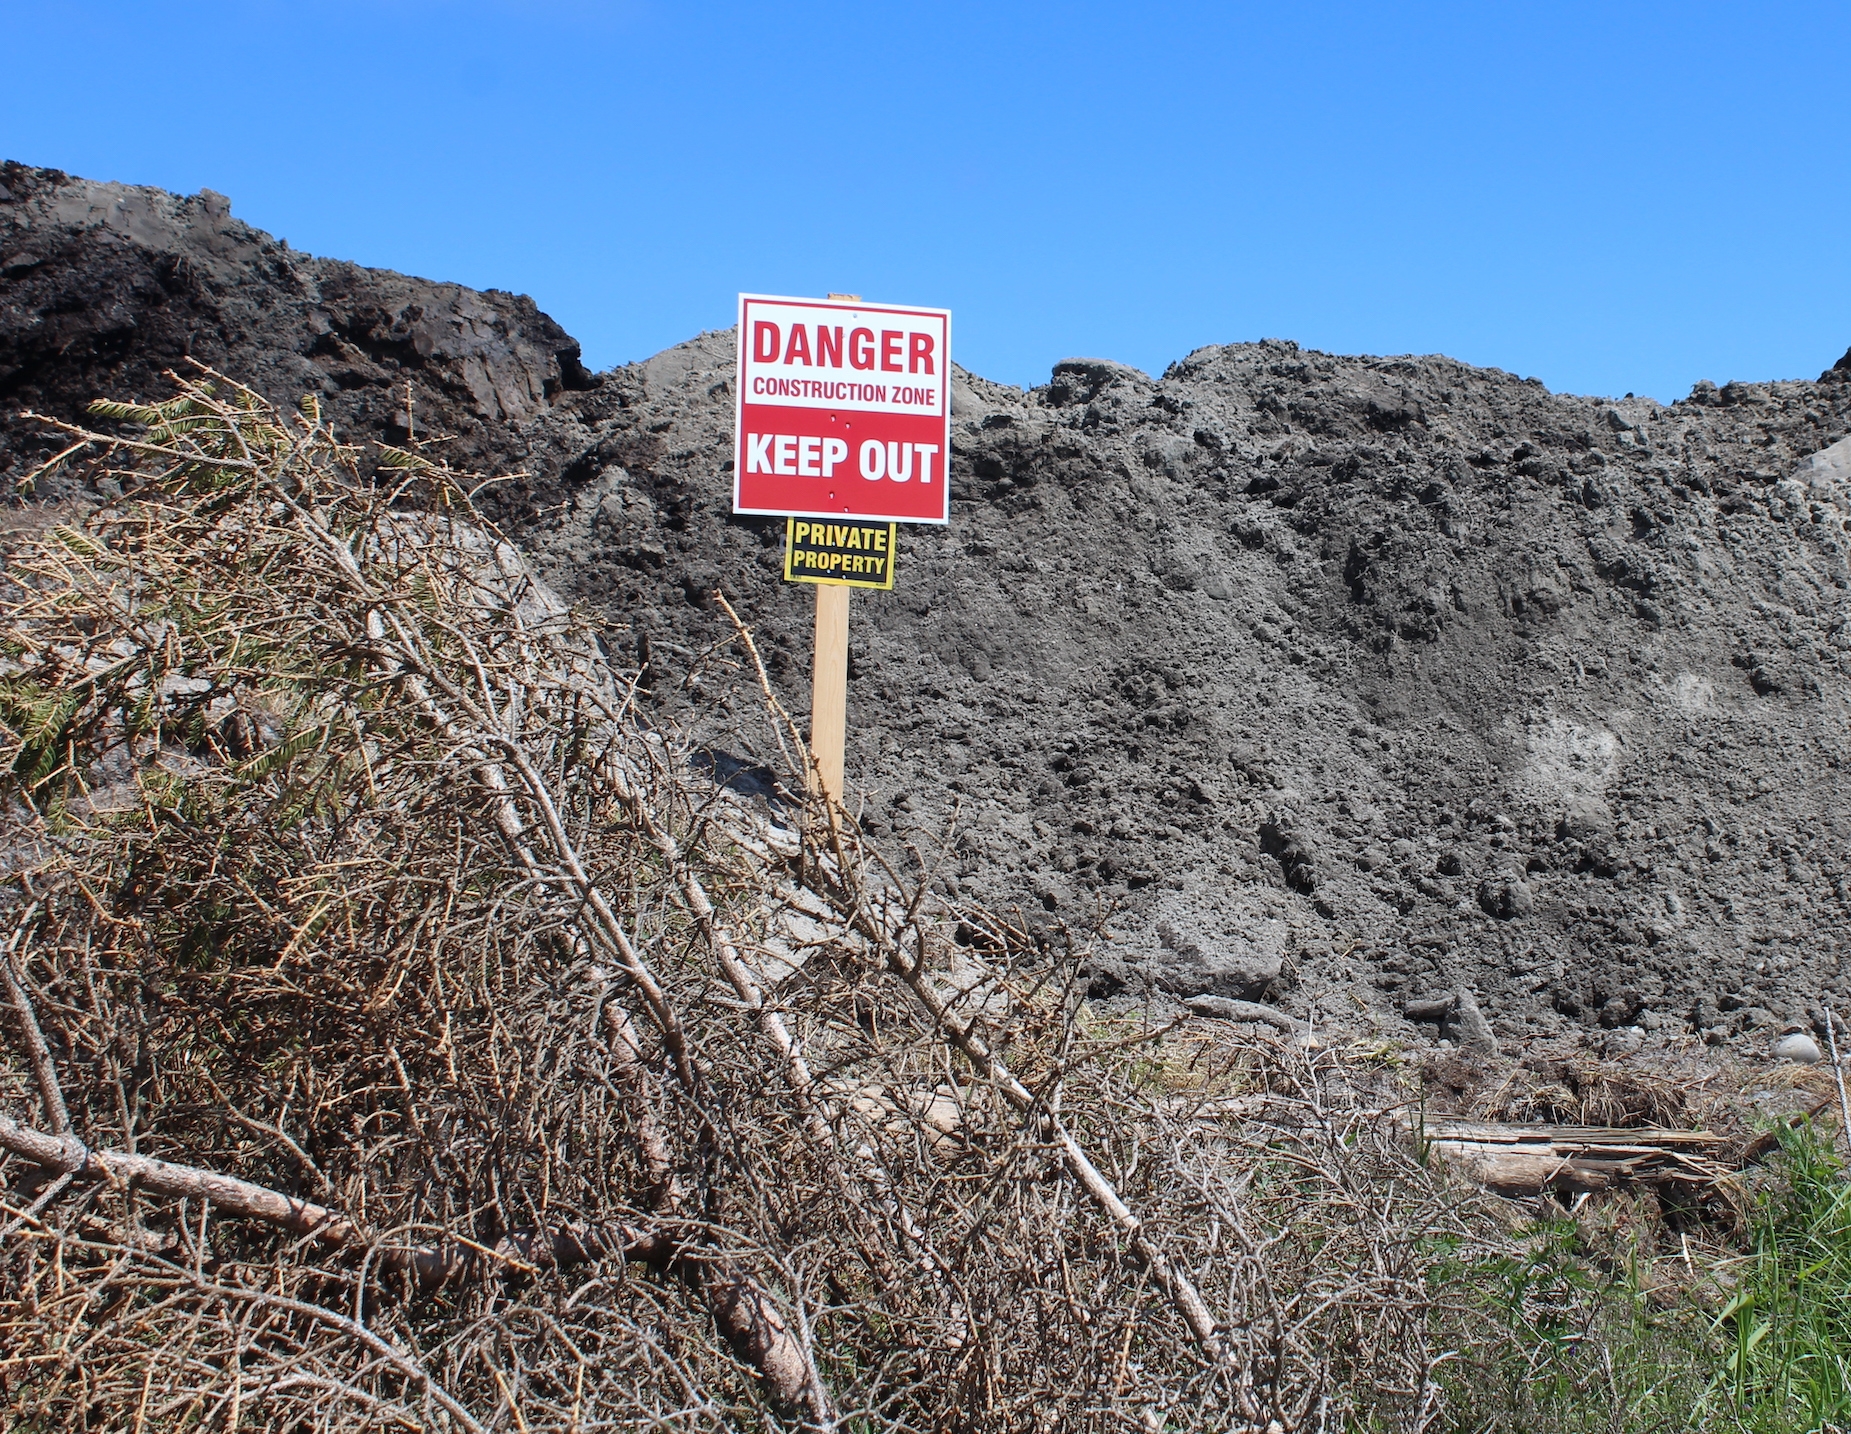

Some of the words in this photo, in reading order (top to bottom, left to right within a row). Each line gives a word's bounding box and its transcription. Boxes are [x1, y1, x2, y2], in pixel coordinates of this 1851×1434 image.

[753, 320, 935, 375] DANGER
[753, 377, 887, 403] CONSTRUCTION
[891, 386, 935, 406] ZONE
[746, 433, 848, 478] KEEP
[859, 439, 939, 483] OUT
[795, 522, 887, 551] PRIVATE
[793, 550, 885, 574] PROPERTY
